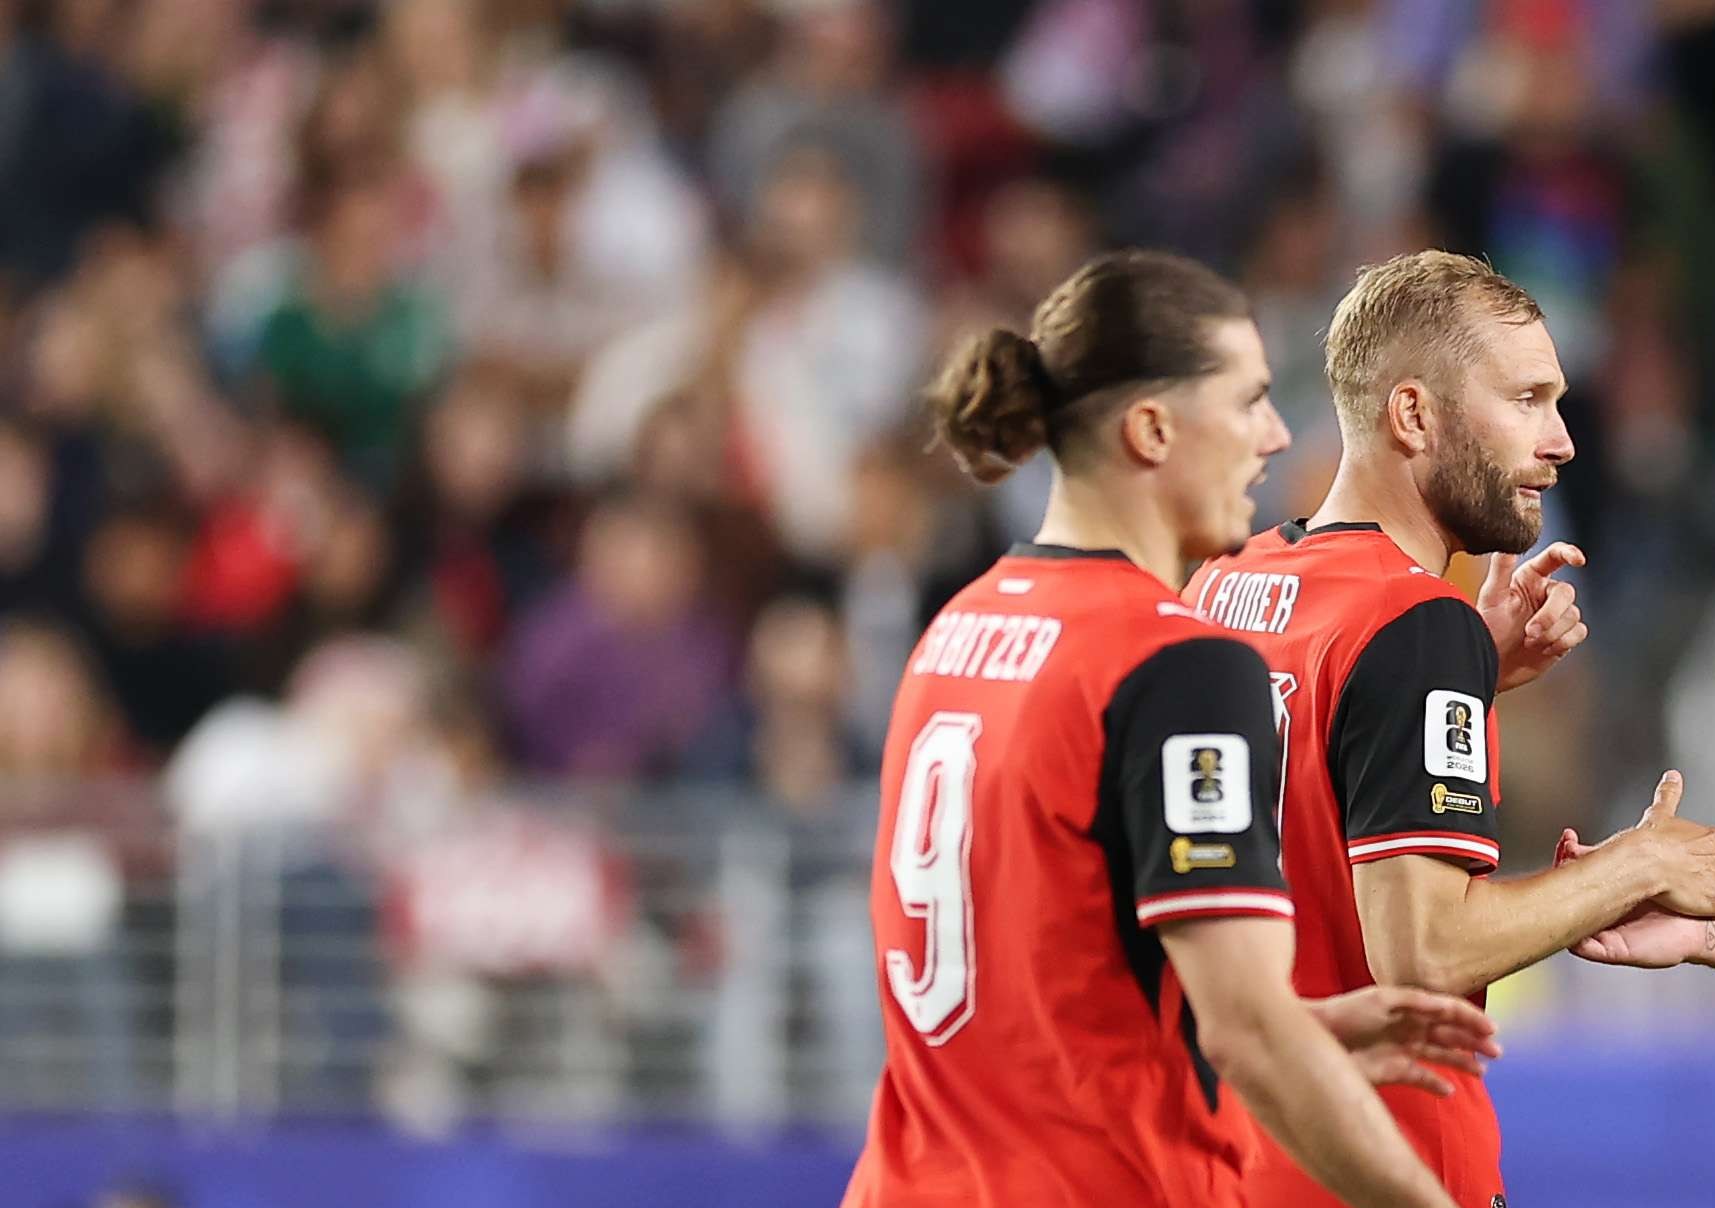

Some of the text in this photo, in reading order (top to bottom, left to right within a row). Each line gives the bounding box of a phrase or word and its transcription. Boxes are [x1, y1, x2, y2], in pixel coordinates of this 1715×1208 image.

[1197, 568, 1300, 634] LAIMER
[1445, 796, 1478, 807] DEBUT
[886, 711, 984, 1047] 9
